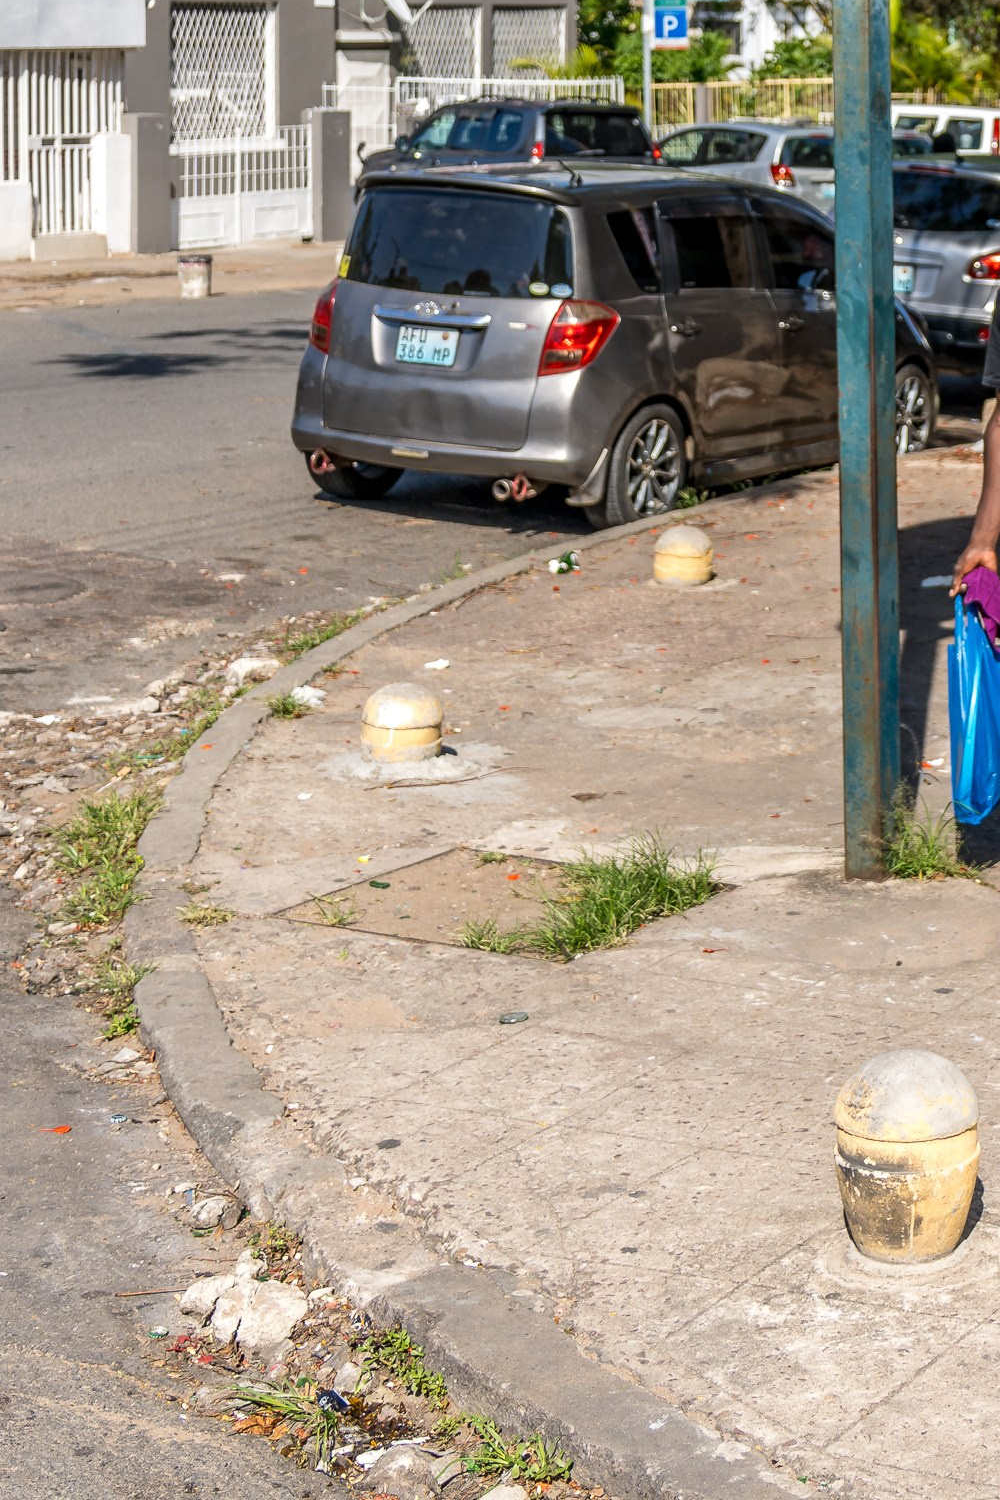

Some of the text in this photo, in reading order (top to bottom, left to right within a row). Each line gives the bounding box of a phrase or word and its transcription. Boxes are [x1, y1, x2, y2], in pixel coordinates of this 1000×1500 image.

[662, 15, 679, 39] P
[399, 343, 451, 362] 386 MP
